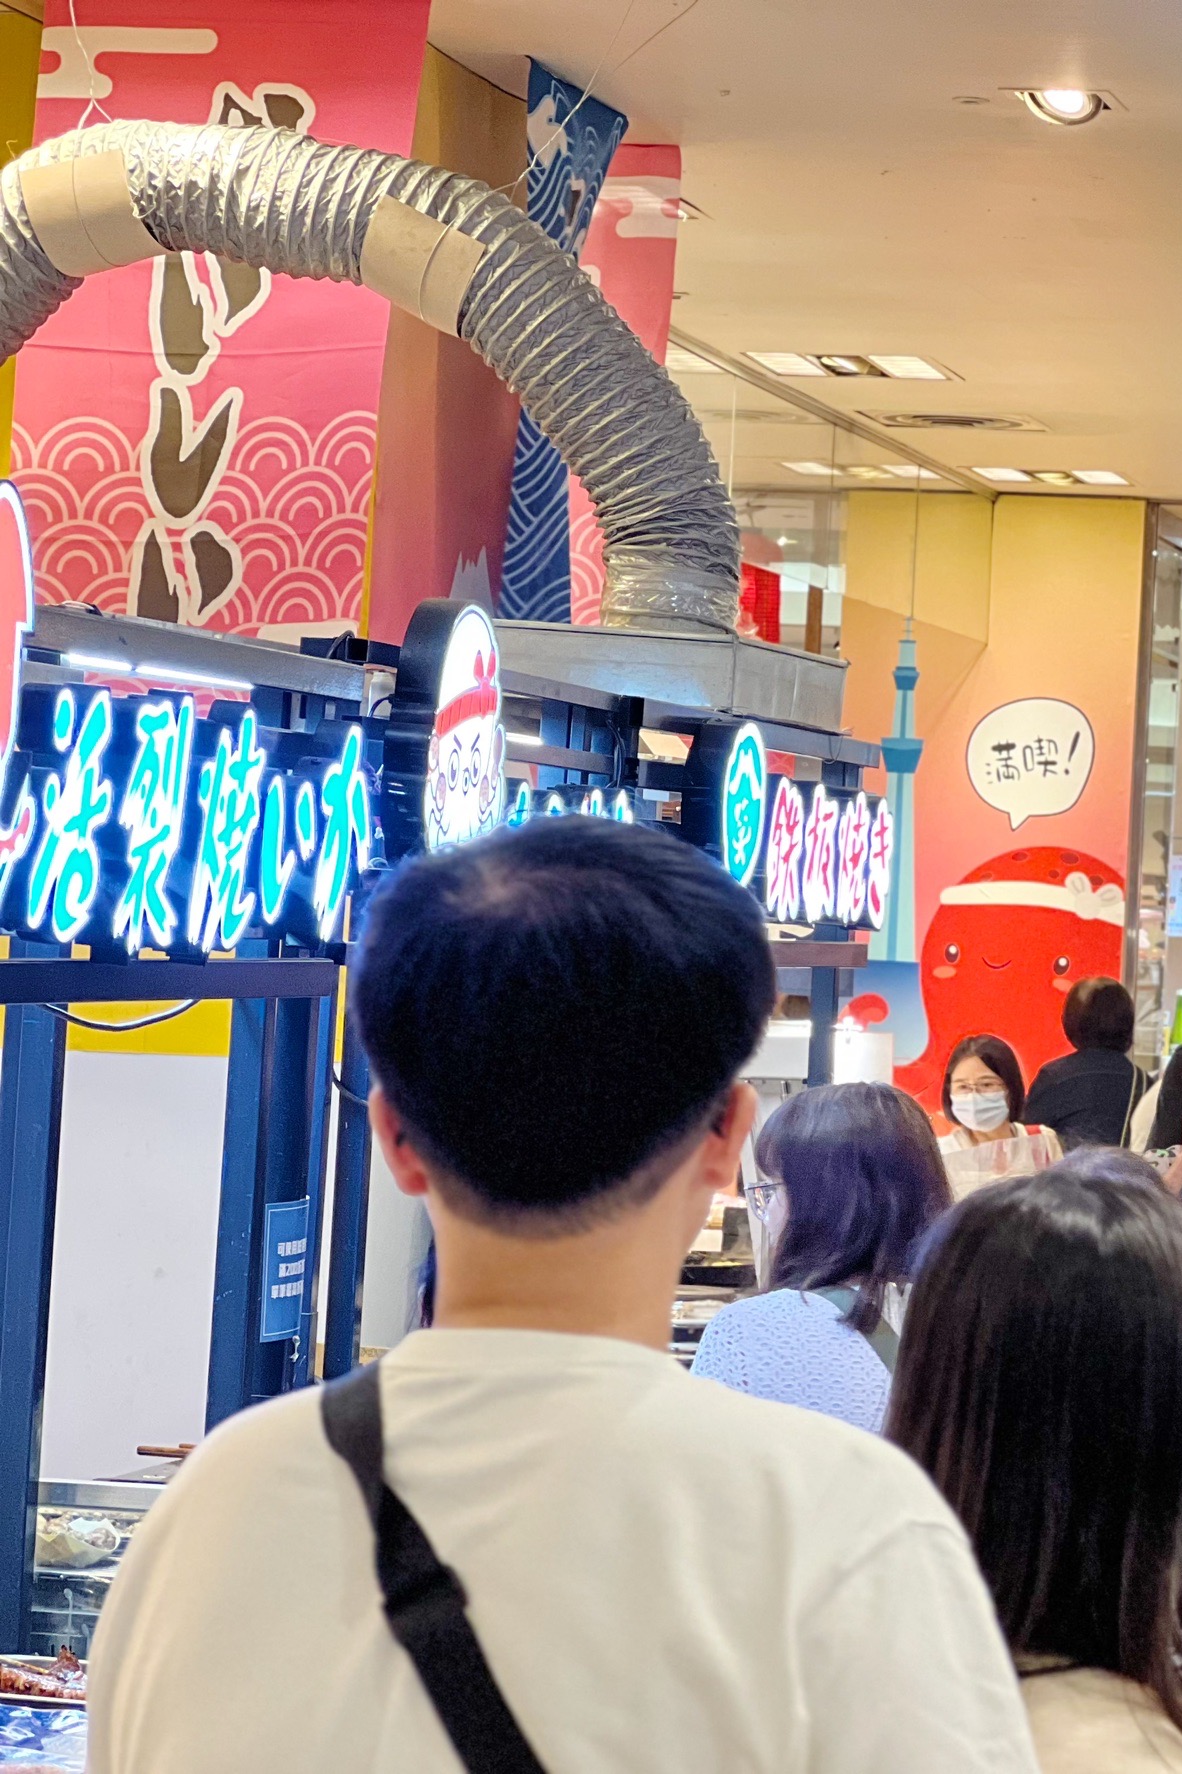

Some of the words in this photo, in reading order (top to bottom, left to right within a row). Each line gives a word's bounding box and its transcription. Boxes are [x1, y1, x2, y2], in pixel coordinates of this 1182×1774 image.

[133, 88, 307, 624] いしい
[767, 777, 893, 929] 鉄板焼き
